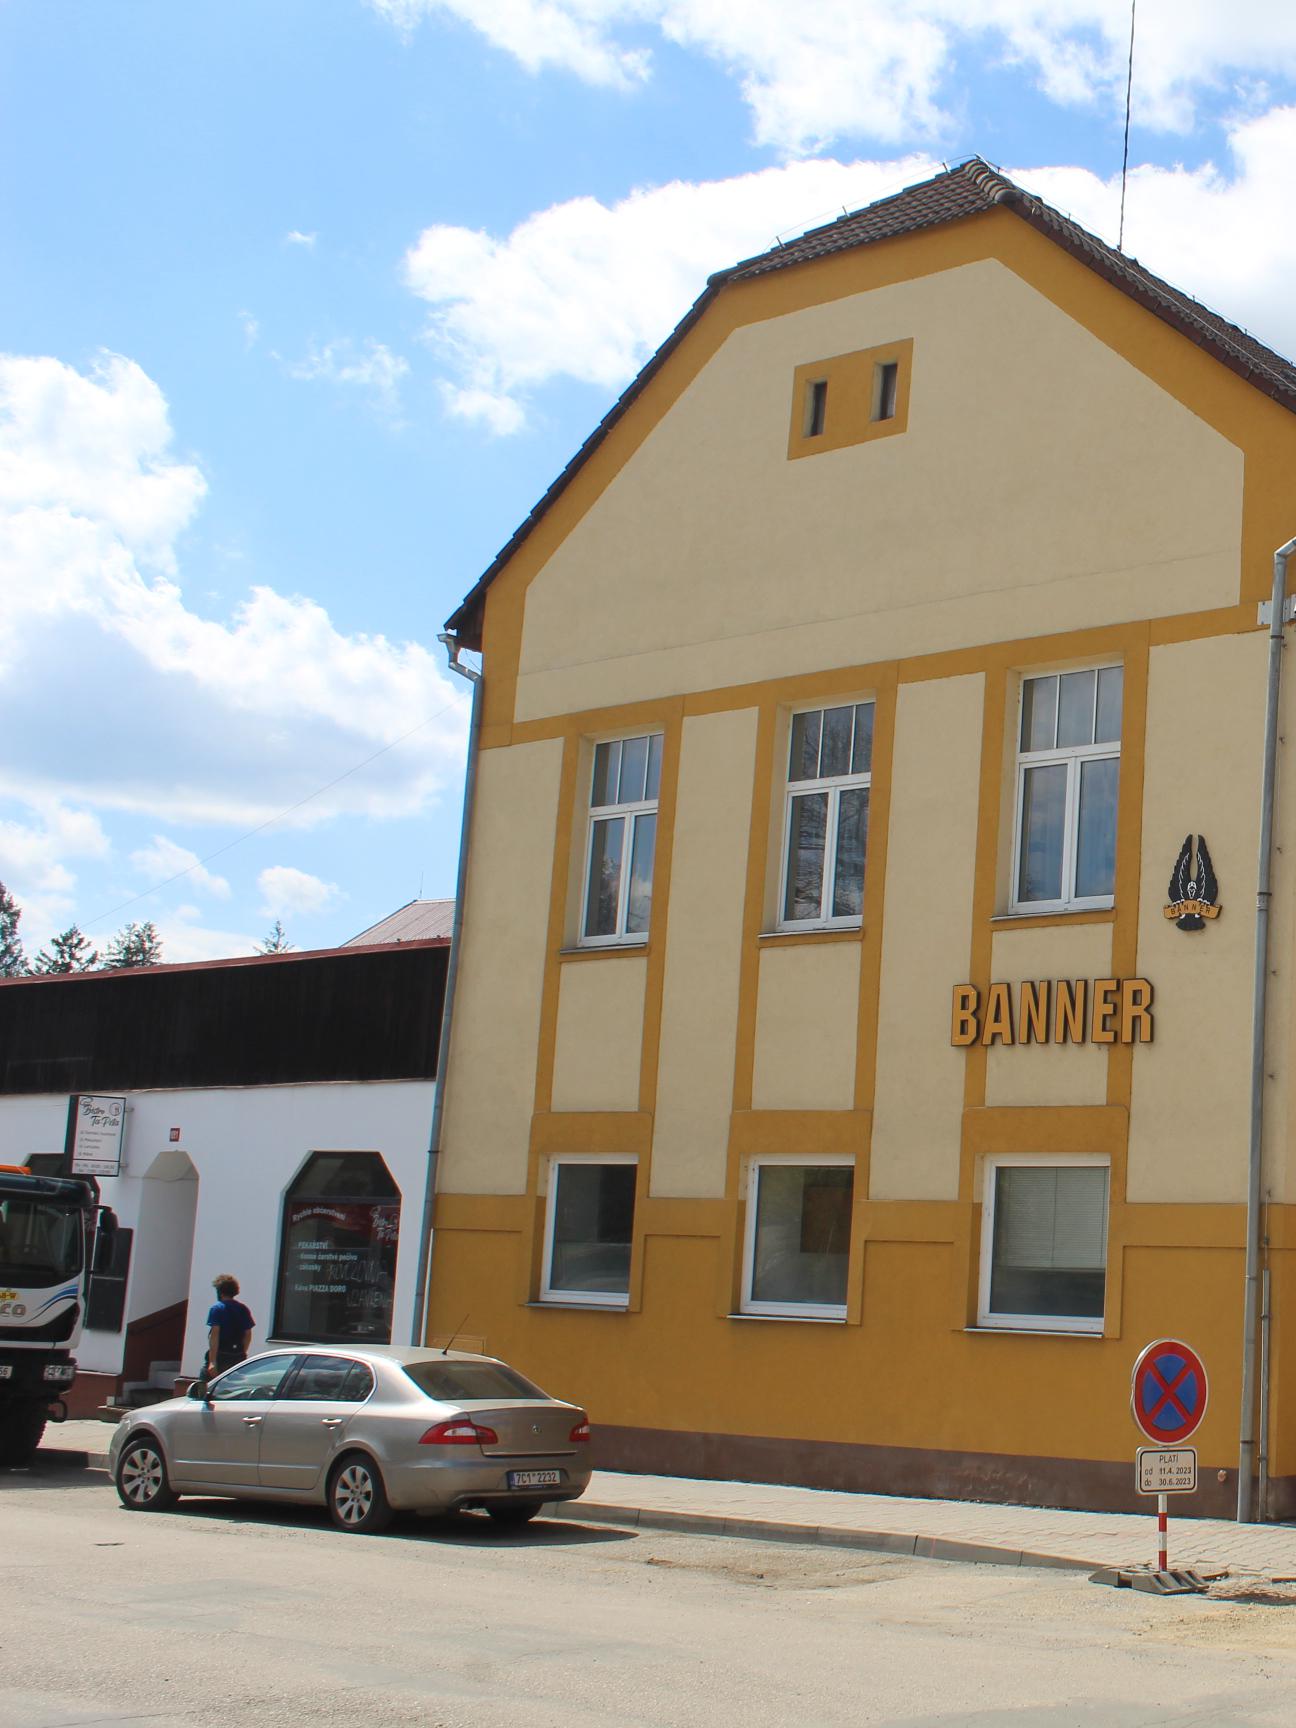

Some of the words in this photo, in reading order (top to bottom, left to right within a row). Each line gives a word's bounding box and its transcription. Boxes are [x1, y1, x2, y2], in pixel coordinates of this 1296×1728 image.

[1170, 904, 1212, 915] BANNER
[951, 978, 1154, 1046] BANNER
[1159, 1454, 1179, 1464] PLATÍ
[1144, 1467, 1153, 1475] od
[1176, 1467, 1192, 1475] 2023
[516, 1472, 532, 1484] 7C1
[538, 1471, 557, 1483] 2232
[1144, 1478, 1152, 1487] do
[1175, 1477, 1192, 1486] 2023
